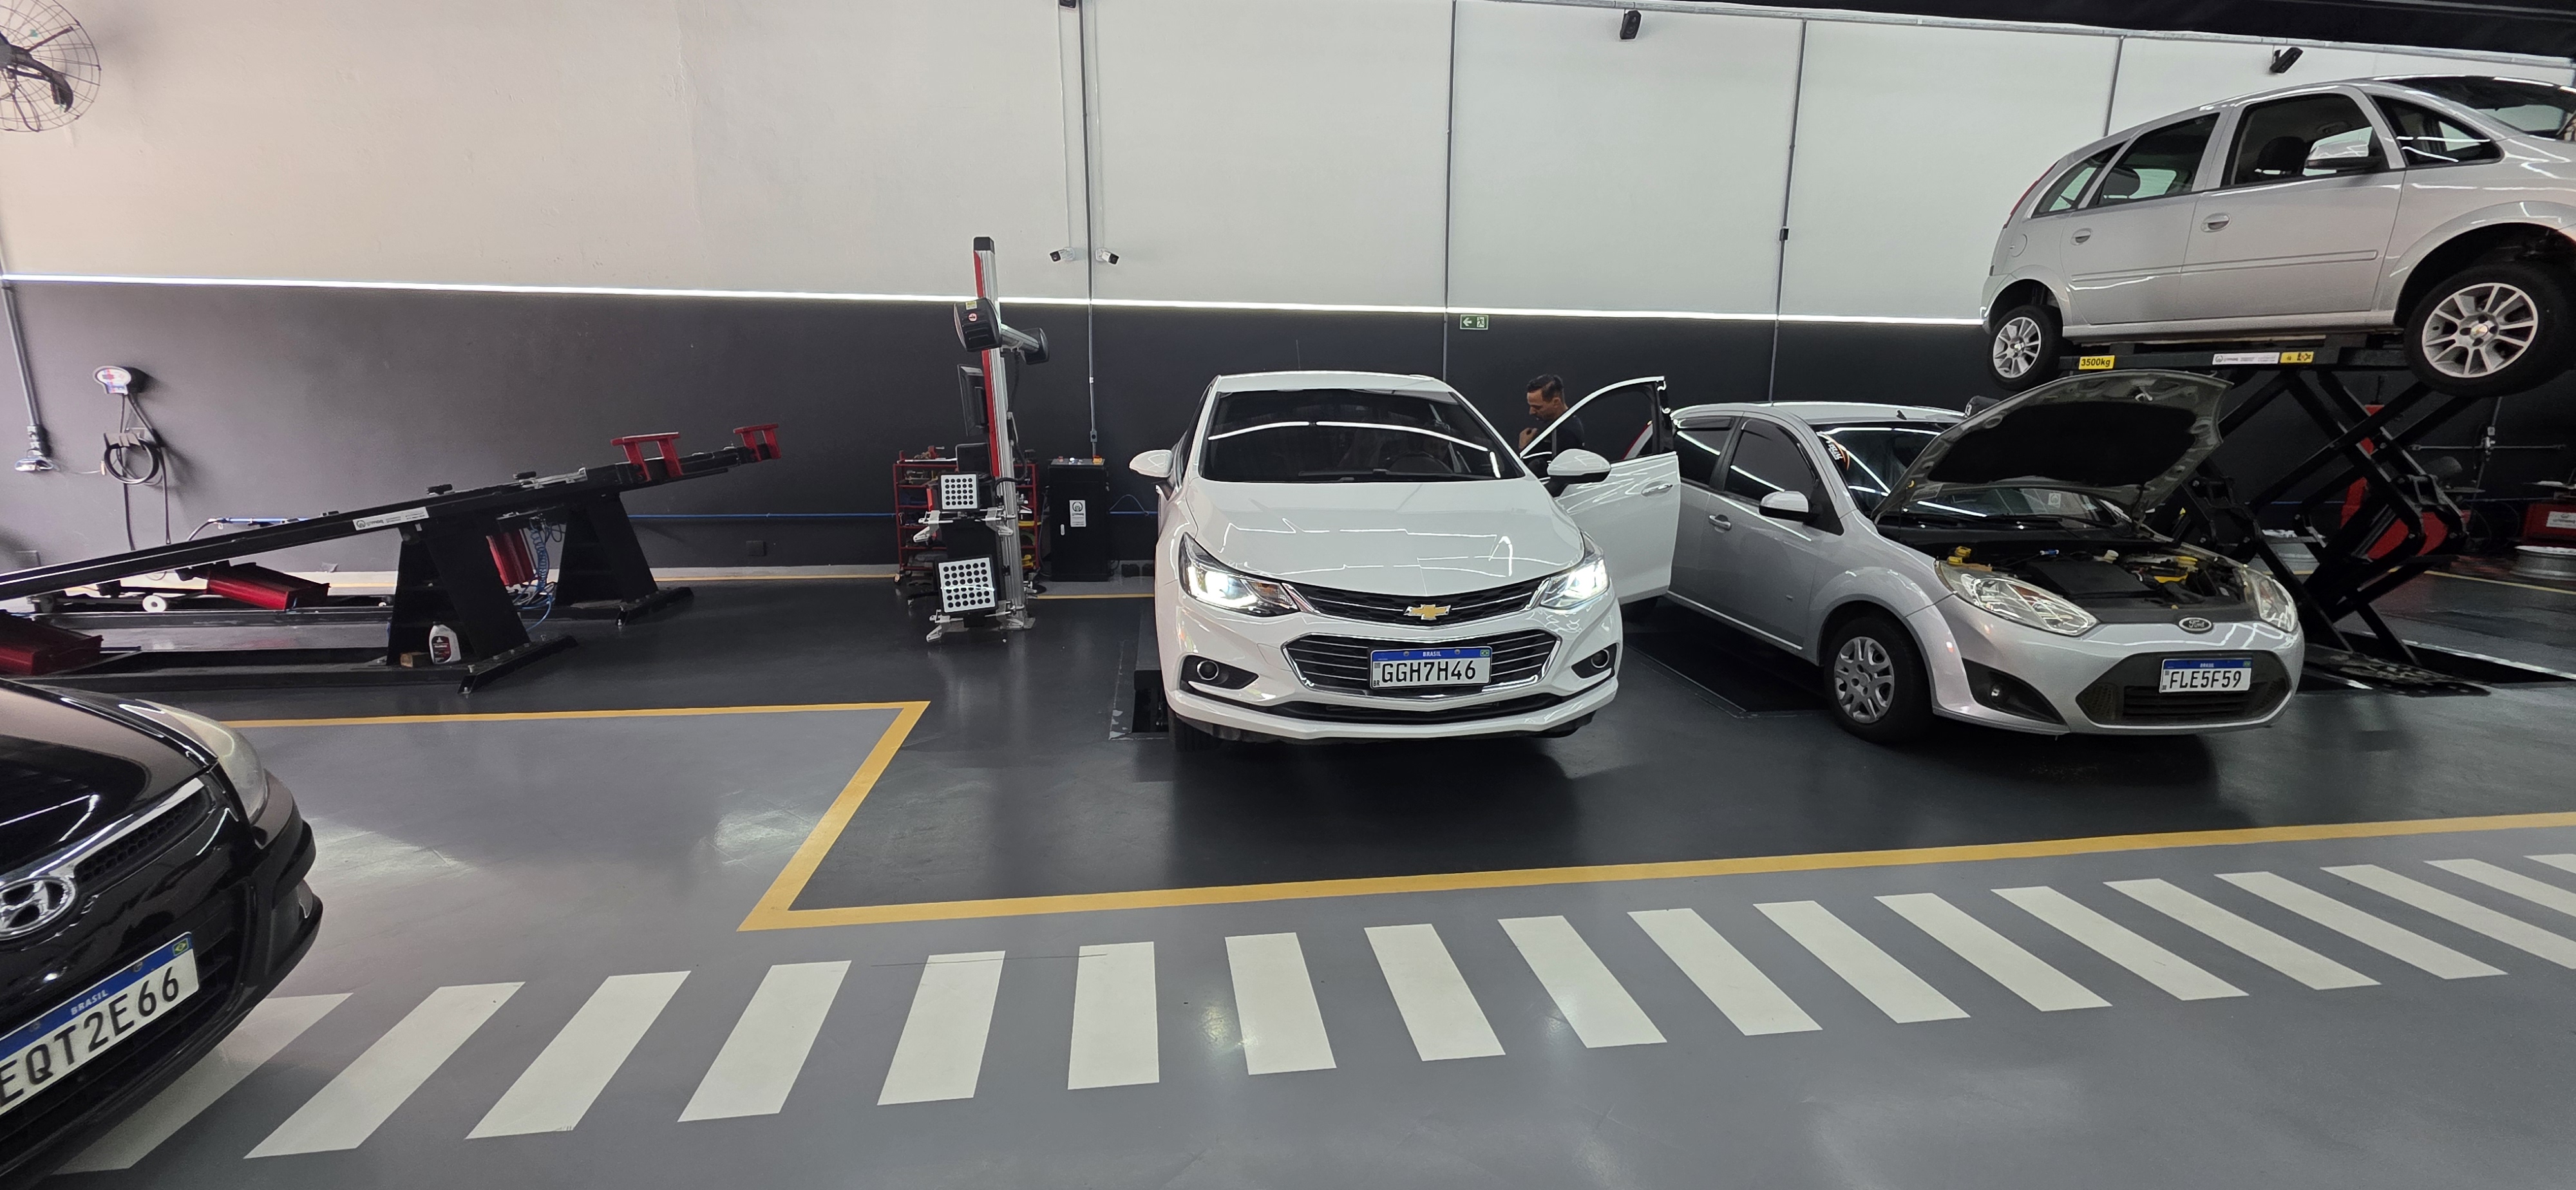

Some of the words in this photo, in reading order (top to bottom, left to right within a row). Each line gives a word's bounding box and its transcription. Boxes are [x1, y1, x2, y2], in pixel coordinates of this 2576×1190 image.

[2081, 358, 2111, 367] 3500kg
[2188, 619, 2205, 628] Ford
[1381, 660, 1476, 683] GGH7H46
[2169, 670, 2242, 688] FLE5F59
[71, 990, 109, 1015] BRASIL
[0, 967, 179, 1107] EQT2E66
